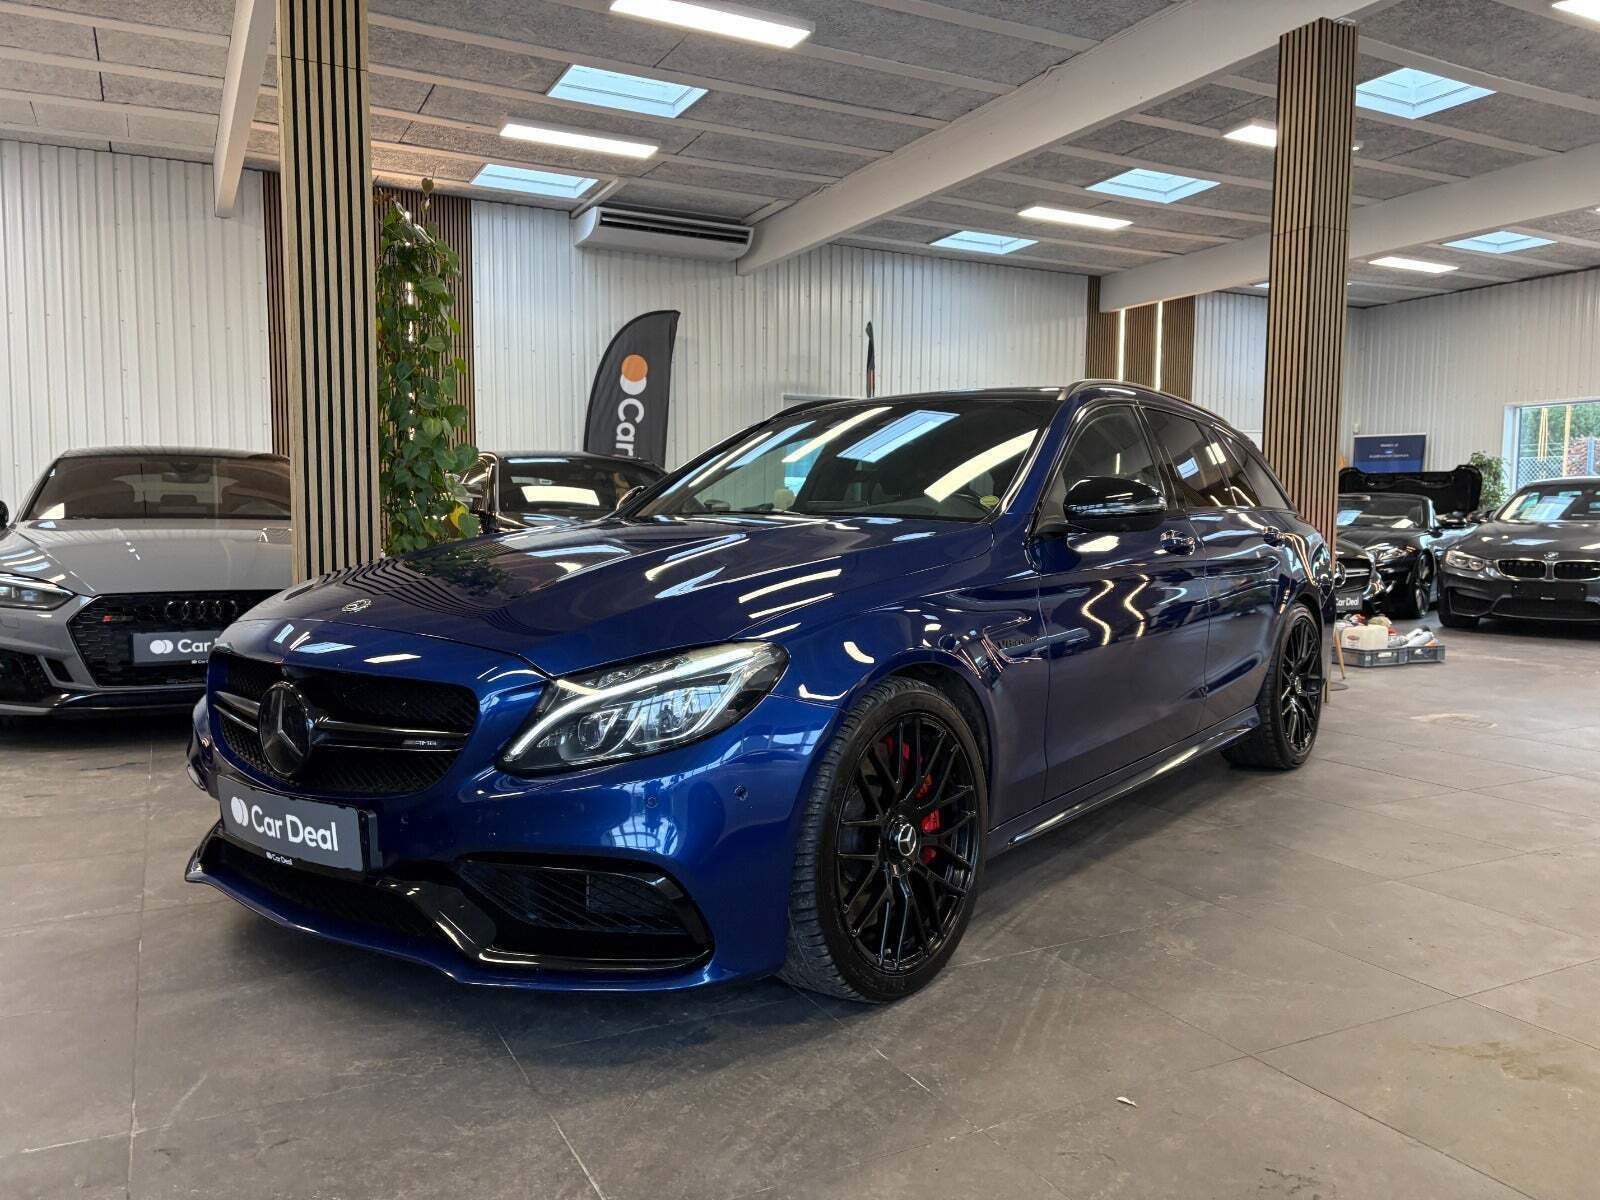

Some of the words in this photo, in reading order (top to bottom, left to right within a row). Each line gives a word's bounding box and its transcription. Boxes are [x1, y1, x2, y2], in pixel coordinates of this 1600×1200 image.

[616, 398, 645, 457] Car
[1346, 596, 1360, 606] Deal
[177, 638, 212, 653] Car
[251, 804, 283, 839] Car
[285, 813, 339, 852] Deal
[271, 853, 280, 863] Car
[280, 855, 293, 866] Deal
